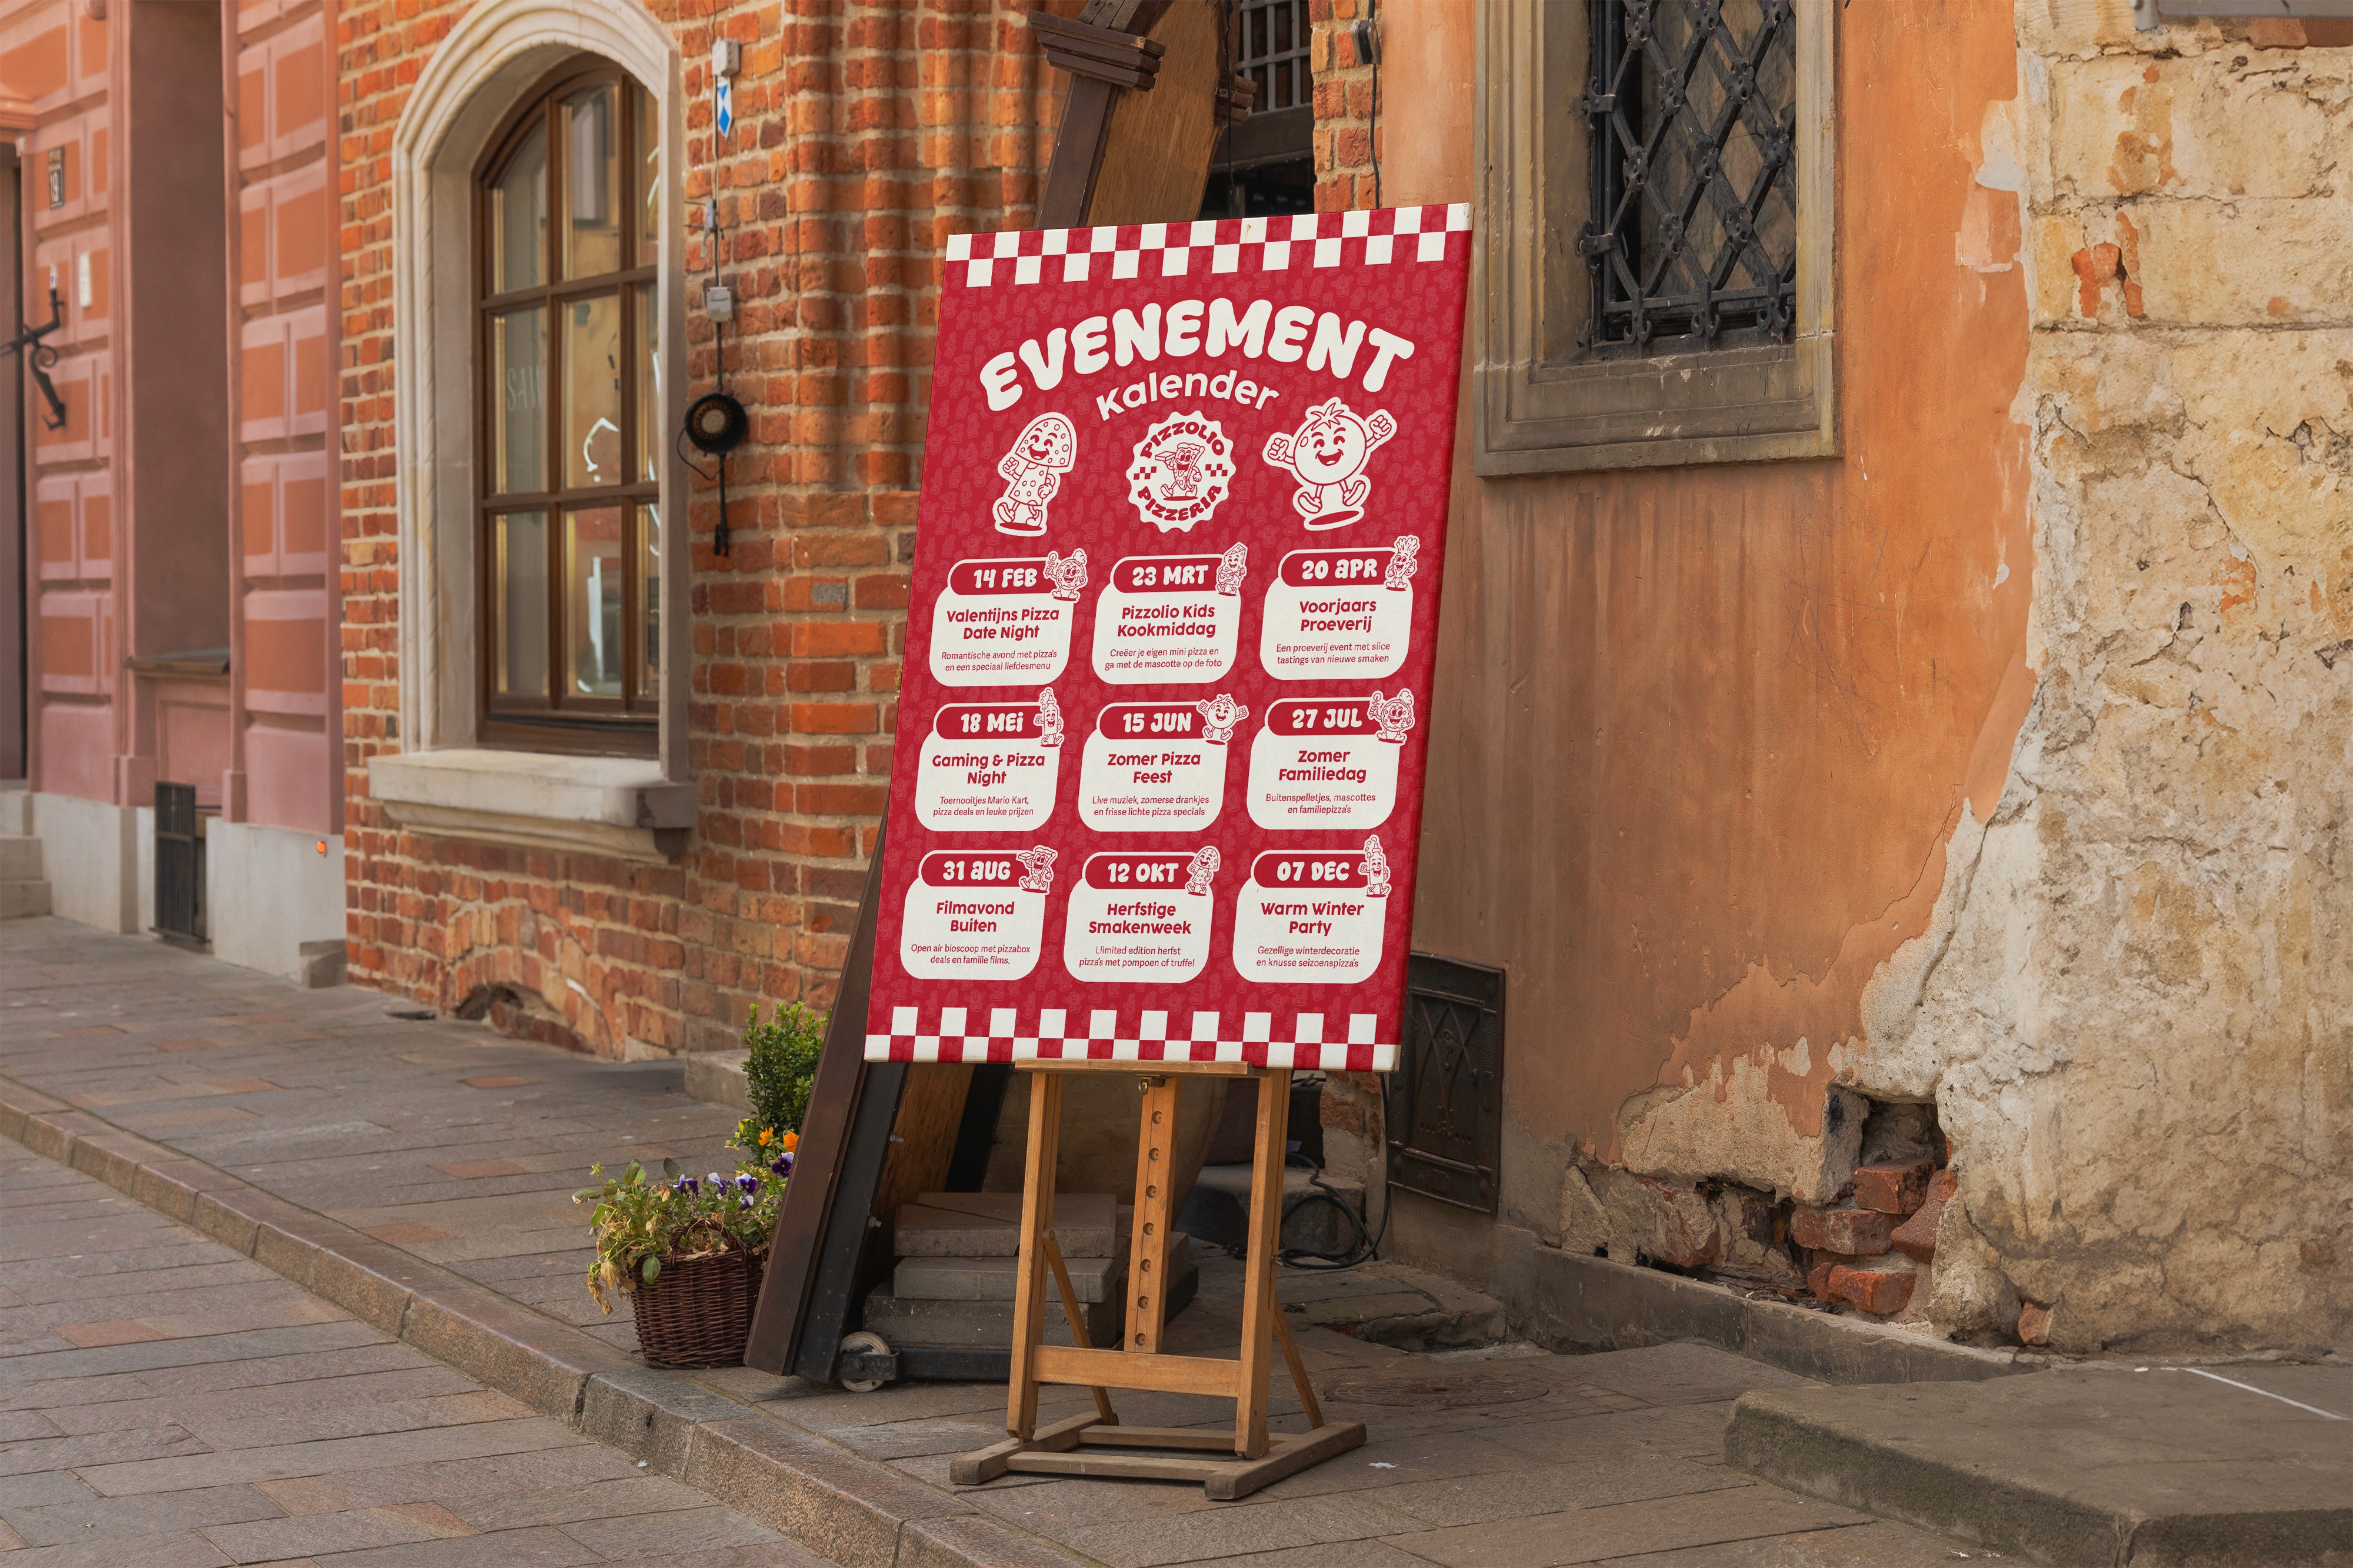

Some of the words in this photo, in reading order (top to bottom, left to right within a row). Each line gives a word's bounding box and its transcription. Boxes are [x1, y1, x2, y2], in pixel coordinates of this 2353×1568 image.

[979, 298, 1414, 411] EVENEMENT
[1096, 370, 1279, 421] Kalender
[1140, 422, 1224, 459] PIZZOLIO
[1138, 485, 1222, 521] PIZZERIA
[1132, 566, 1156, 586] 23
[1164, 565, 1208, 585] MRT
[1302, 561, 1328, 579] 20
[974, 569, 996, 588] 14
[1002, 568, 1037, 588] FEB
[1122, 605, 1179, 619] Pizzolio
[1183, 604, 1215, 618] Kids
[1300, 598, 1377, 615] Voorjaars
[947, 608, 1018, 624] Valentijns
[1022, 607, 1059, 620] Pizza
[1118, 622, 1216, 638] Kookmiddag
[1301, 616, 1372, 633] Proeverij
[964, 626, 996, 639] Date
[1001, 625, 1039, 641] Night
[942, 651, 991, 659] Romantische
[992, 650, 1015, 659] avond
[1136, 649, 1145, 658] je
[1146, 648, 1167, 658] eigen
[1188, 648, 1207, 657] pizza
[1293, 643, 1328, 653] proeverij
[972, 662, 1002, 672] speciaal
[1005, 662, 1050, 670] liefdesmenu
[1278, 656, 1309, 666] tastings
[1358, 654, 1389, 662] smaken
[961, 713, 981, 733] 18
[1124, 713, 1144, 732] 15
[1151, 712, 1192, 732] JUN
[1292, 709, 1318, 728] 27
[1324, 708, 1362, 728] JUL
[932, 753, 988, 769] Gaming
[992, 755, 1003, 766] &
[1007, 753, 1045, 766] Pizza
[1108, 754, 1158, 766] Zomer
[1162, 752, 1201, 765] Pizza
[1298, 750, 1351, 762] Zomer
[968, 770, 1006, 786] Night
[1134, 770, 1172, 783] Feest
[1279, 766, 1366, 783] Familiedag
[940, 796, 986, 806] Toernooitjes
[1012, 796, 1029, 805] Kart,
[1110, 796, 1139, 805] muziek,
[1176, 795, 1209, 806] drankjes
[1266, 793, 1331, 803] Buitenspelletjes,
[934, 808, 952, 817] pizza
[1009, 808, 1033, 817] prijzen
[1152, 808, 1171, 817] pizza
[1174, 808, 1205, 817] specials
[943, 861, 965, 880] 31
[1108, 863, 1129, 882] 12
[1136, 863, 1179, 882] OKT
[1277, 862, 1305, 881] 07
[1312, 861, 1349, 880] DEC
[936, 900, 1014, 915] Filmavond
[1108, 902, 1176, 919] Herfstige
[1261, 903, 1307, 915] Warm
[1312, 901, 1364, 915] Winter
[951, 918, 996, 932] Buiten
[1089, 920, 1191, 934] Smakenweek
[1289, 920, 1332, 936] Party
[911, 944, 931, 953] Open
[945, 944, 979, 954] bioscoop
[998, 945, 1030, 954] pizzabox
[1158, 946, 1181, 955] herfst
[1258, 946, 1294, 956] Gezellige
[1296, 946, 1359, 955] winterdecoratie
[990, 956, 1009, 964] films.
[1171, 959, 1194, 967] truffel
[1269, 958, 1297, 966] knusse
